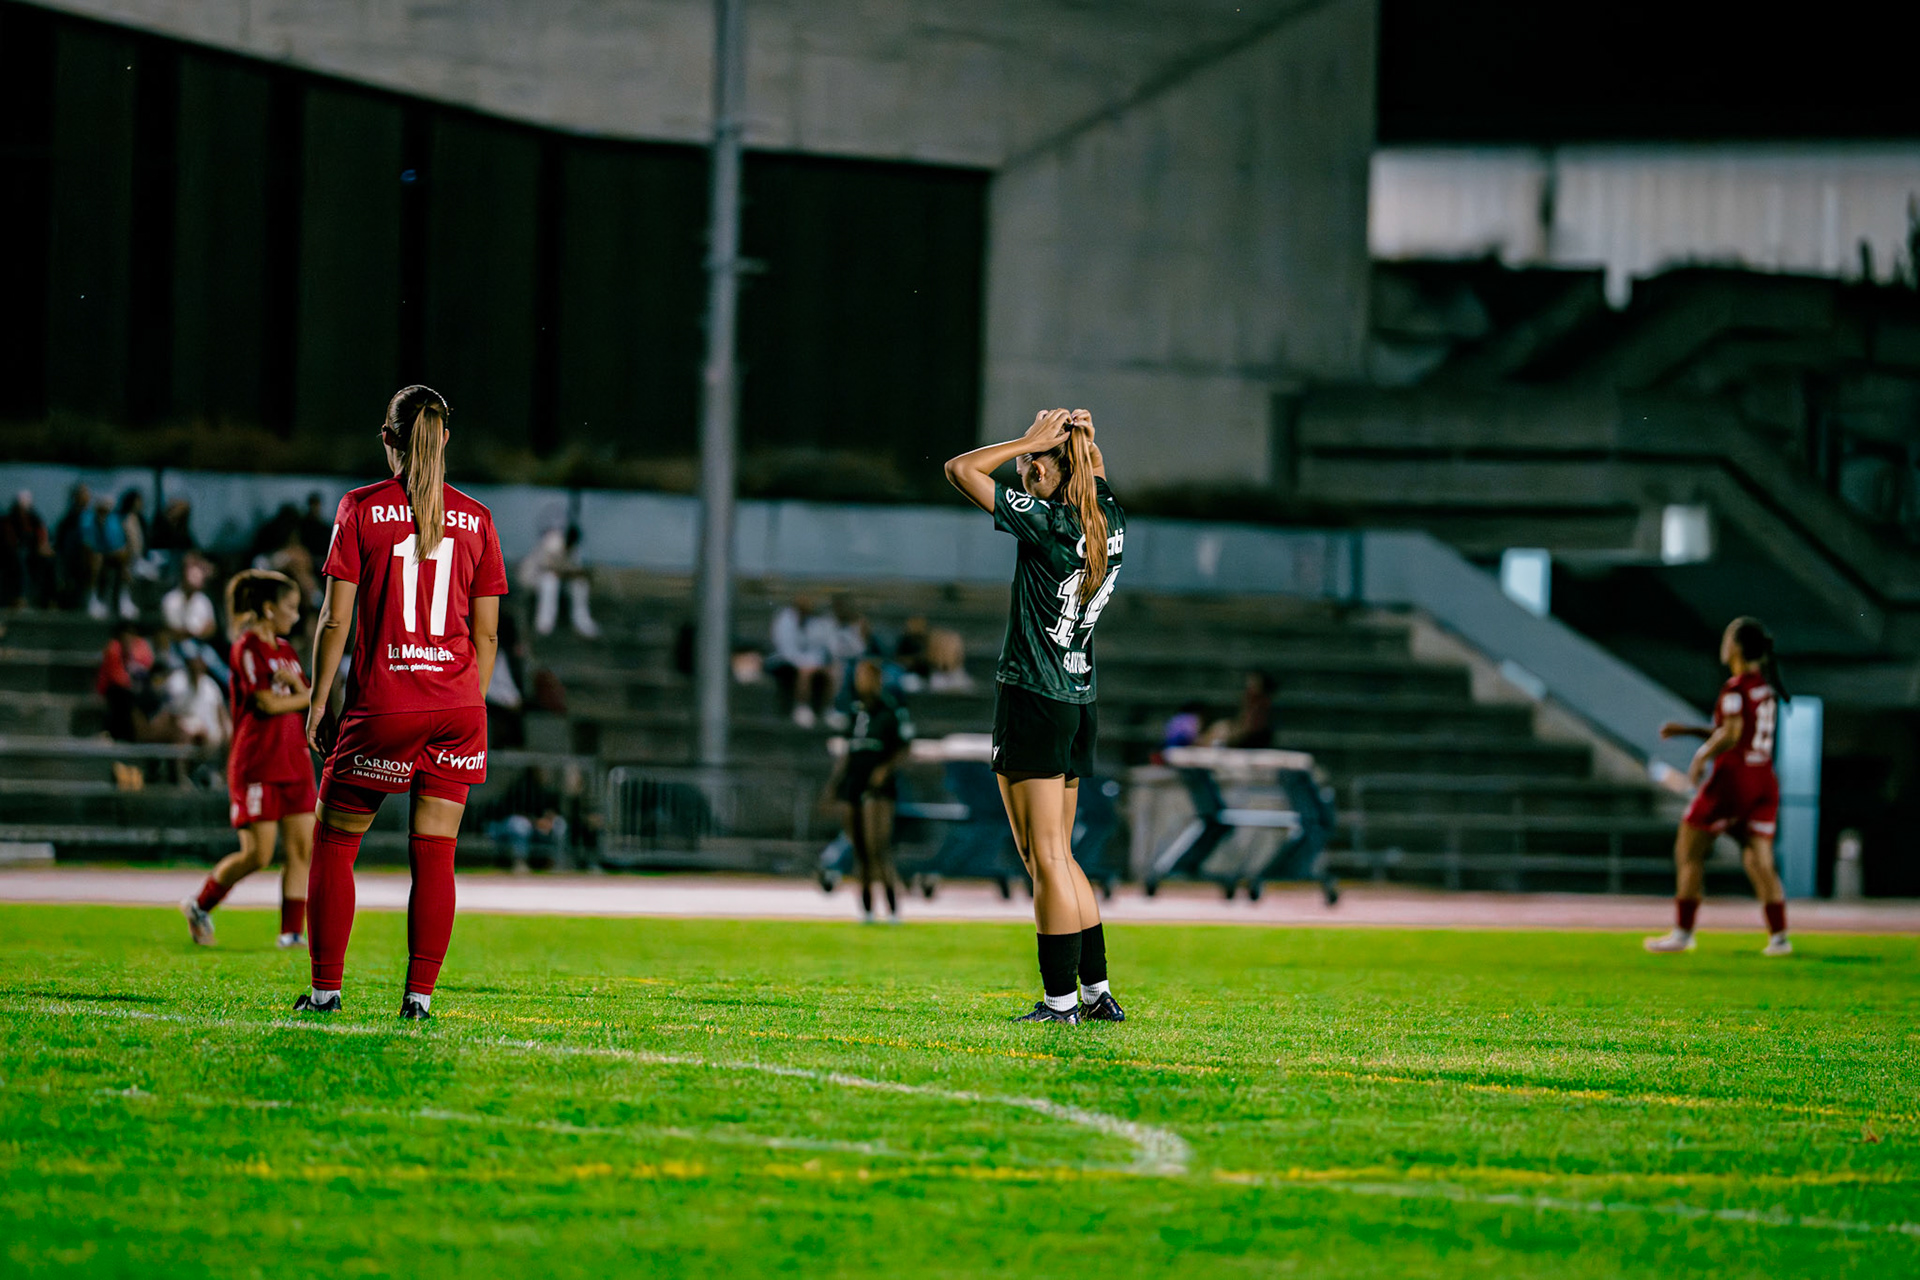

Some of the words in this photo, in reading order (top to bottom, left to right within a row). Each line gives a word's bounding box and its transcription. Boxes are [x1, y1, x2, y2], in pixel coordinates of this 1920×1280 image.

[393, 533, 455, 637] 11
[354, 754, 413, 773] CARRON
[436, 749, 485, 770] i-watt
[353, 769, 403, 783] IMMOBILIER
